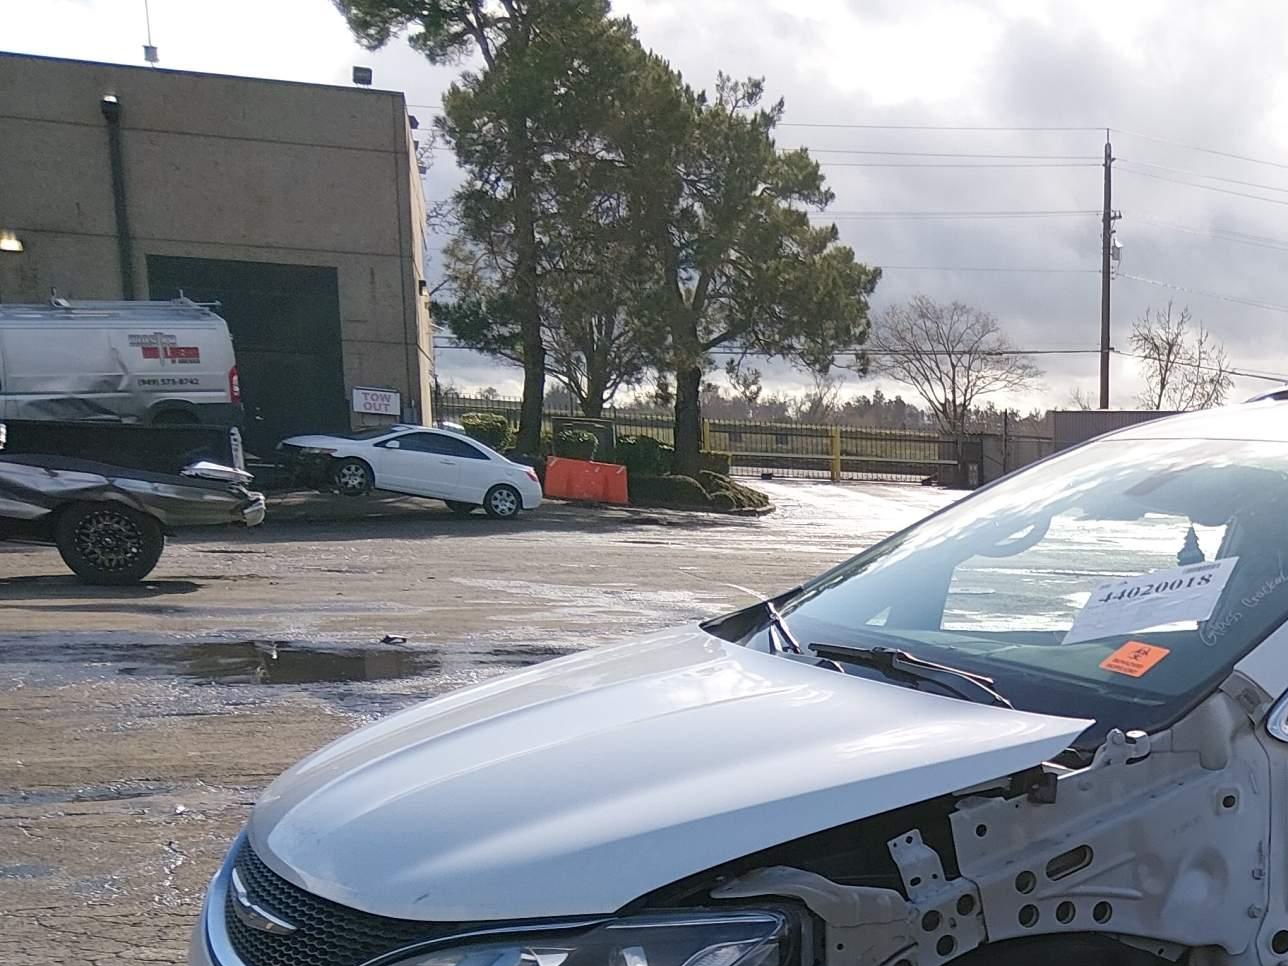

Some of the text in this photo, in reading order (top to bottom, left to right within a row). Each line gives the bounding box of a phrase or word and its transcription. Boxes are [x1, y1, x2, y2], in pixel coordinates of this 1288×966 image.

[361, 392, 392, 403] TOW
[363, 401, 391, 412] OUT
[1098, 573, 1213, 603] 44020018
